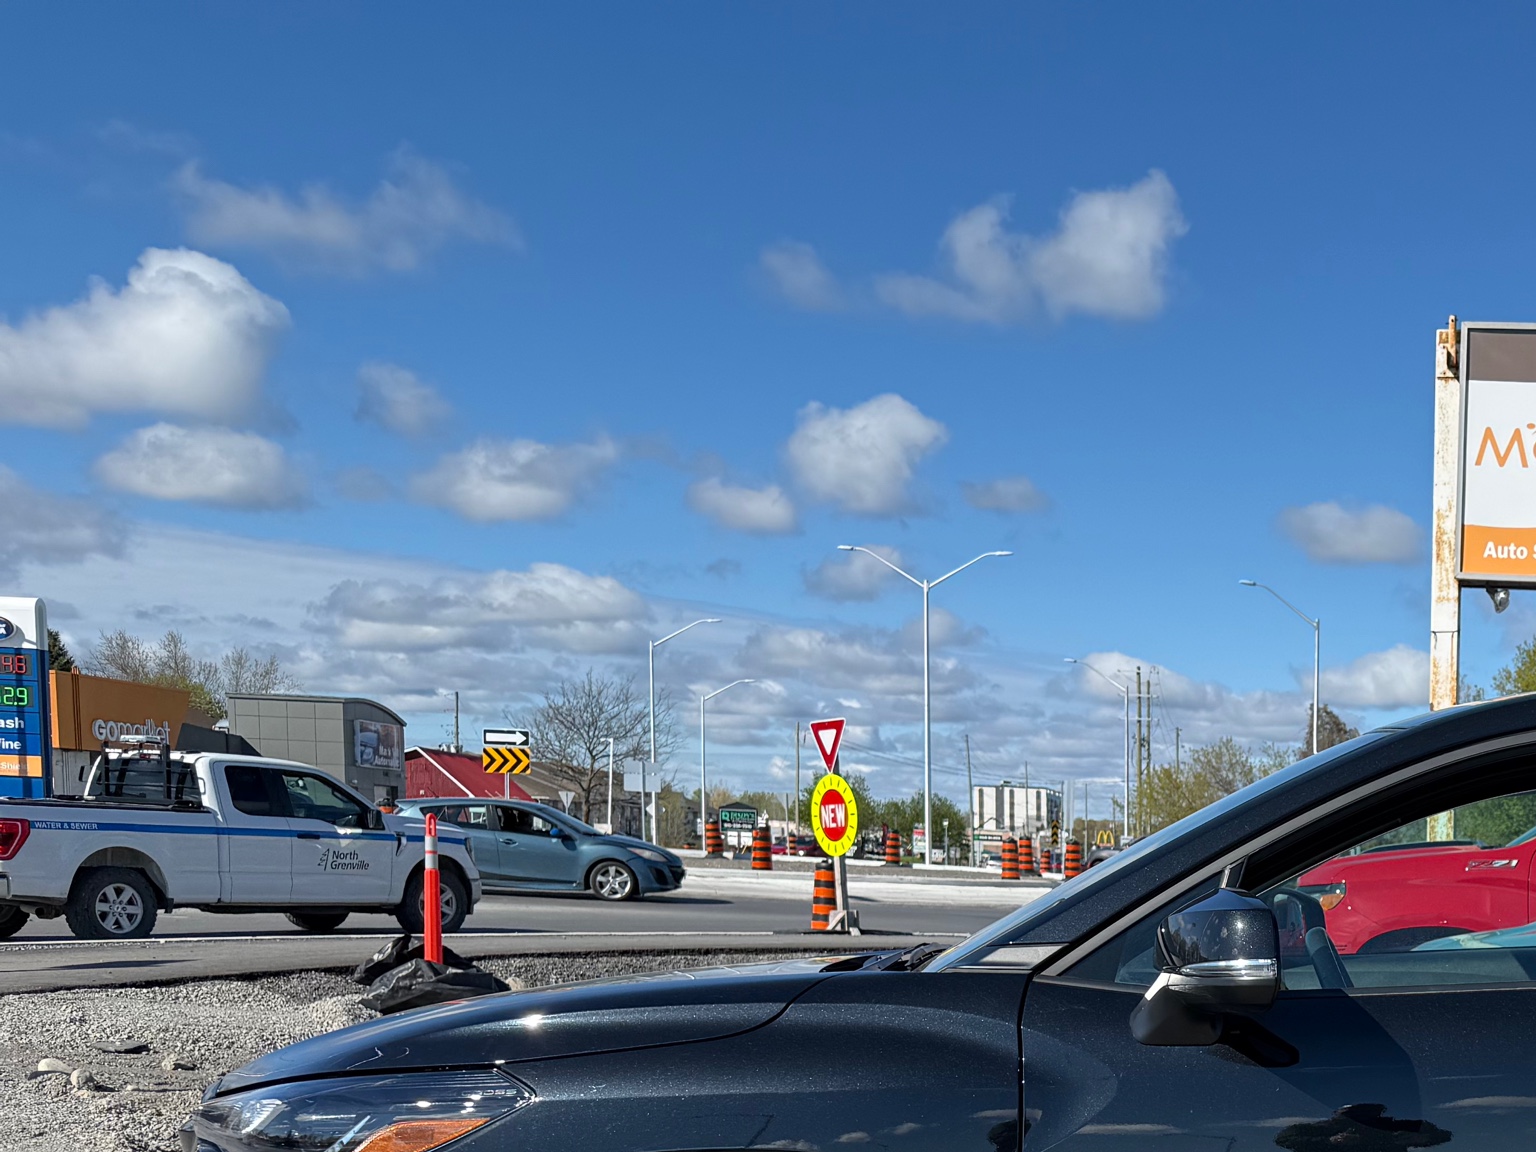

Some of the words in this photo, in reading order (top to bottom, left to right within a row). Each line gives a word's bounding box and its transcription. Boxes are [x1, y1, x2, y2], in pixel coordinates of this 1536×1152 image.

[1483, 541, 1528, 560] Auto
[0, 686, 28, 705] 2.9
[0, 738, 22, 750] ine
[821, 803, 846, 829] NEW
[332, 850, 359, 860] North
[330, 860, 370, 870] Grenville
